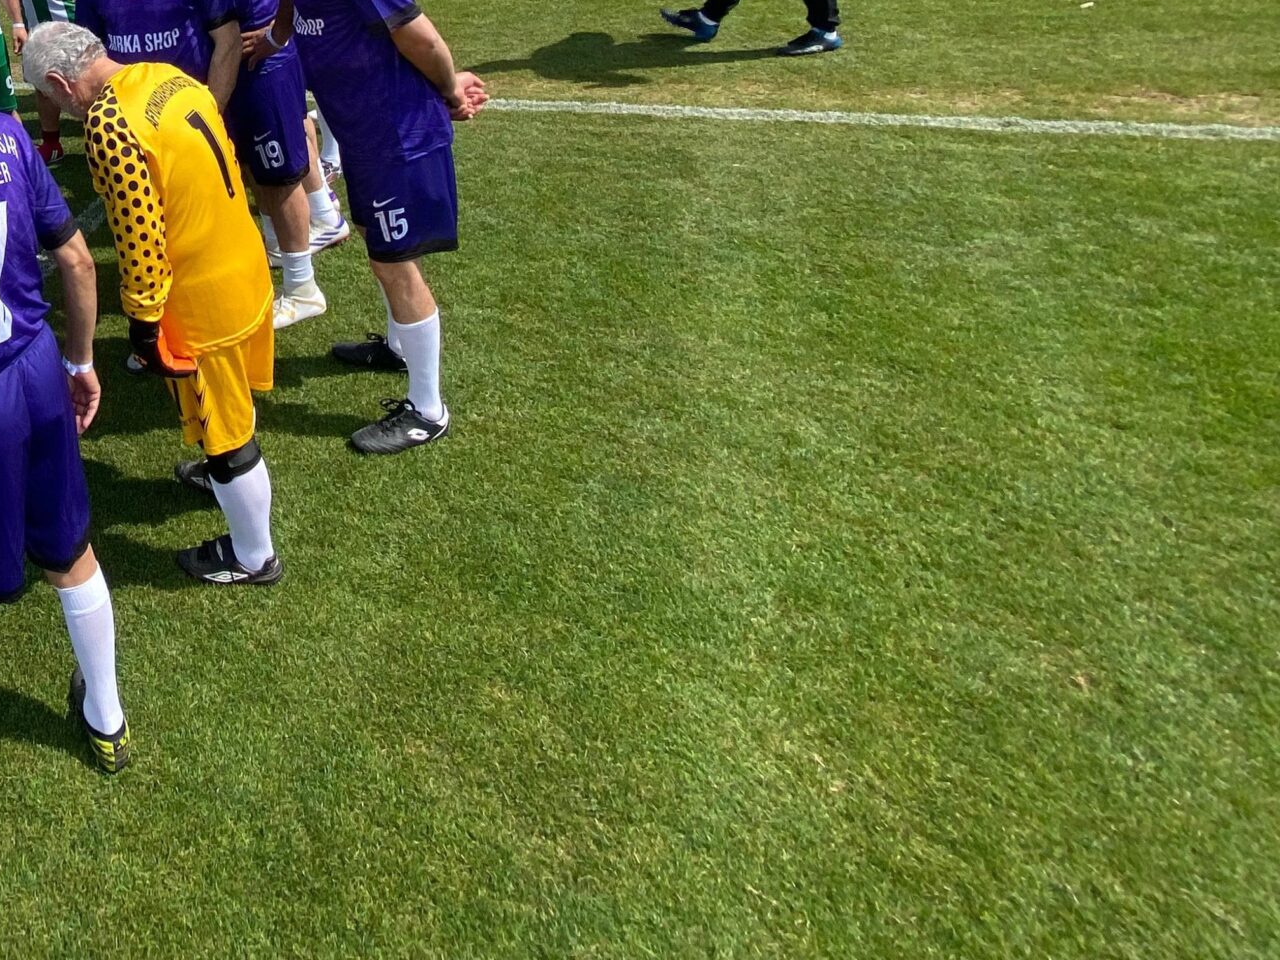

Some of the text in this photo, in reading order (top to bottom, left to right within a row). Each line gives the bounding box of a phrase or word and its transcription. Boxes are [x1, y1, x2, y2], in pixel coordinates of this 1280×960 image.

[145, 28, 180, 52] SHOP
[185, 108, 235, 199] 1
[254, 140, 285, 169] 19
[374, 207, 408, 242] 15
